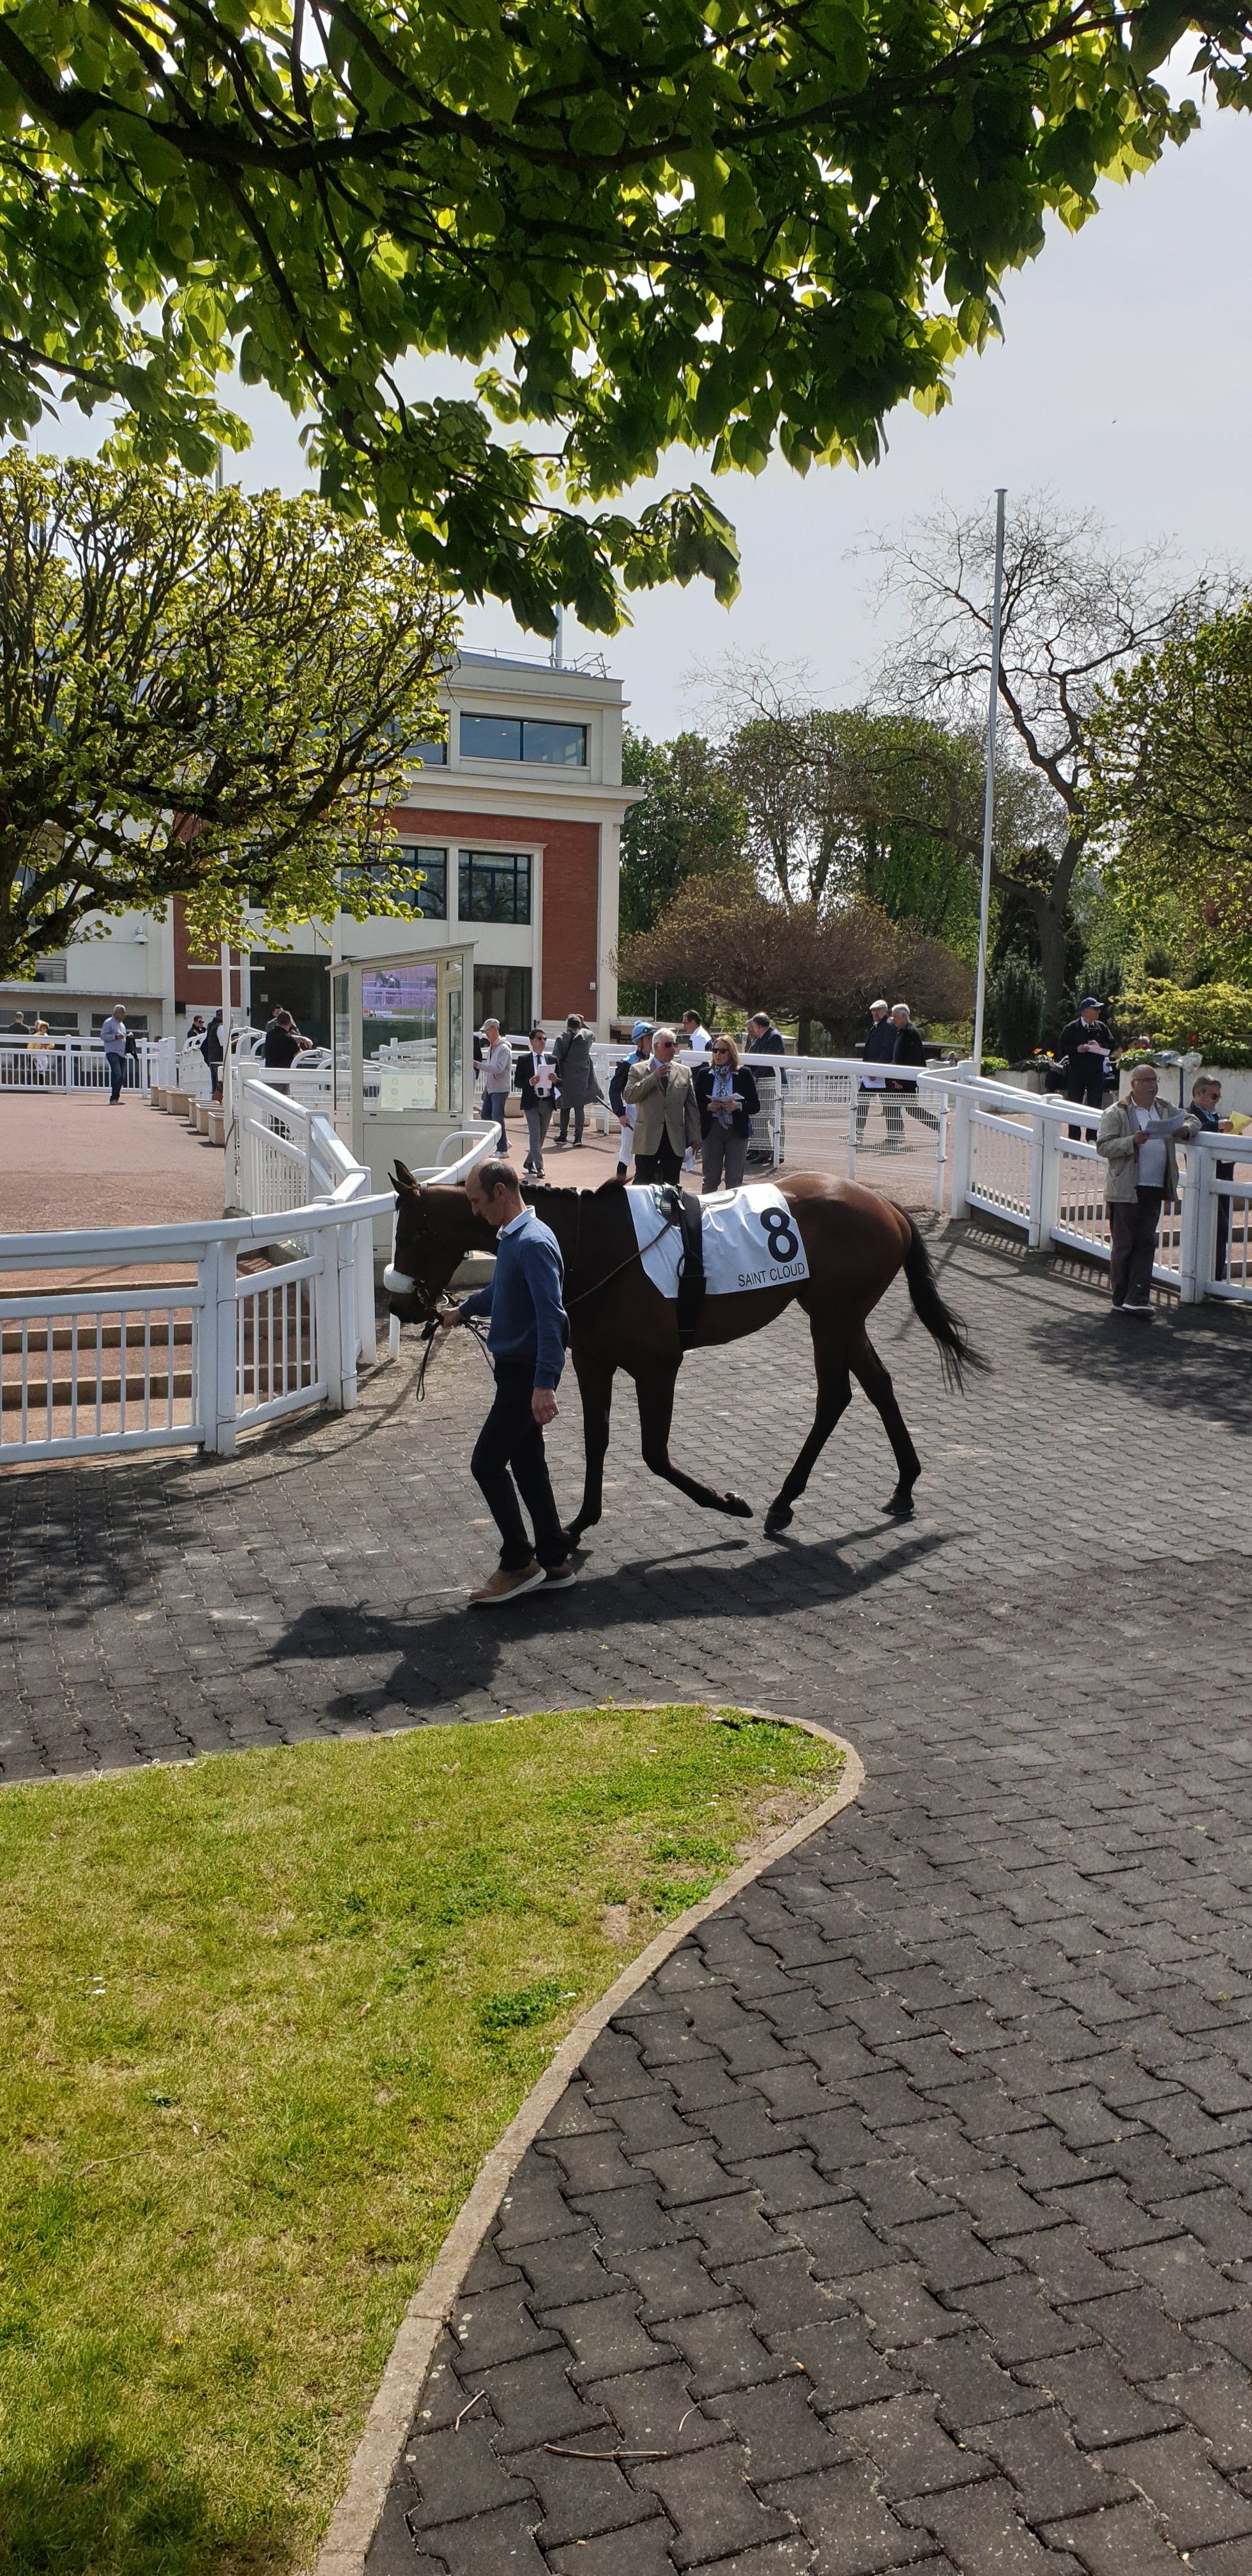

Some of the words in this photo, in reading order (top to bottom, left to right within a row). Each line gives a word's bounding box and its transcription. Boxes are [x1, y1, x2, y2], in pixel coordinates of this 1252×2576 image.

[760, 1207, 798, 1263] 8
[738, 1270, 767, 1287] SAINT
[770, 1262, 805, 1281] CLOUD
